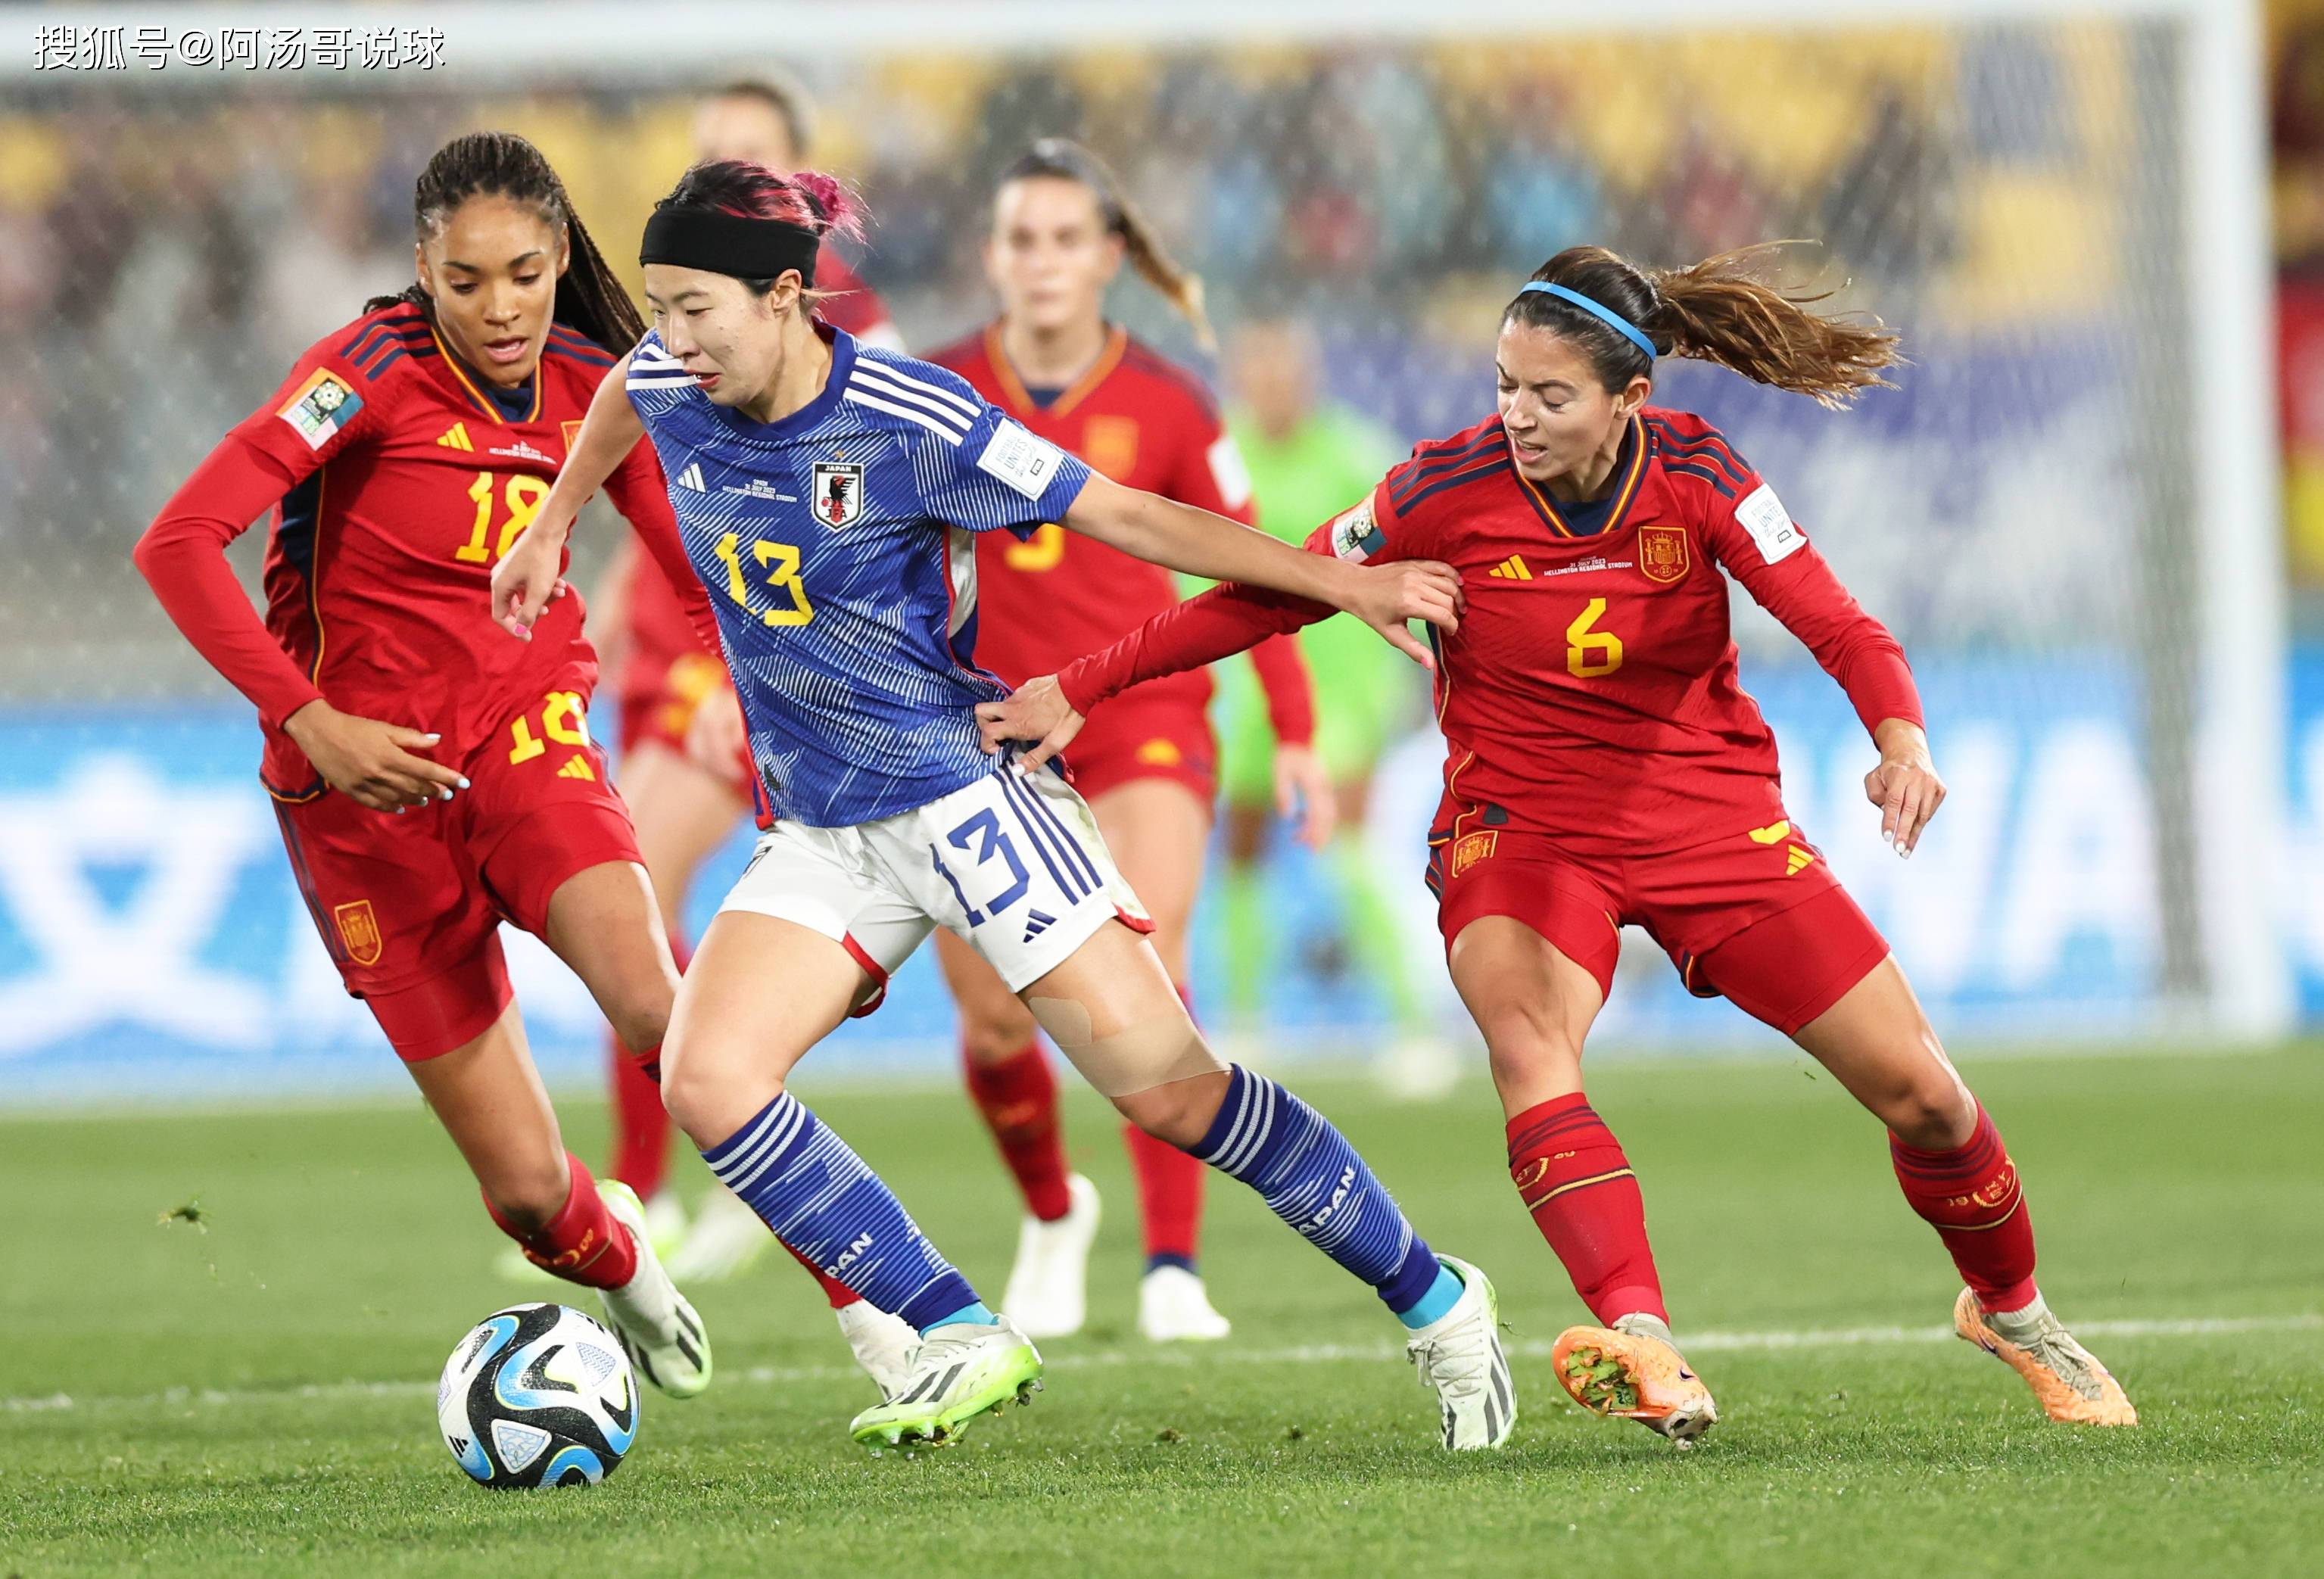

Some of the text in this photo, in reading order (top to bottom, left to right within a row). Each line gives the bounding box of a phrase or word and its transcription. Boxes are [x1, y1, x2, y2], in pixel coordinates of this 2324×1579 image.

[1004, 438, 1028, 469] UNITES
[455, 472, 552, 563] 18
[722, 485, 751, 496] WELLINGTON
[714, 534, 814, 626] 13
[1544, 567, 1578, 576] WELLINGTON
[1579, 564, 1607, 572] REGIONAL
[1566, 597, 1623, 678] 6
[928, 807, 1030, 928] 13
[1298, 1166, 1356, 1235] APAN
[824, 1232, 873, 1278] PAN
